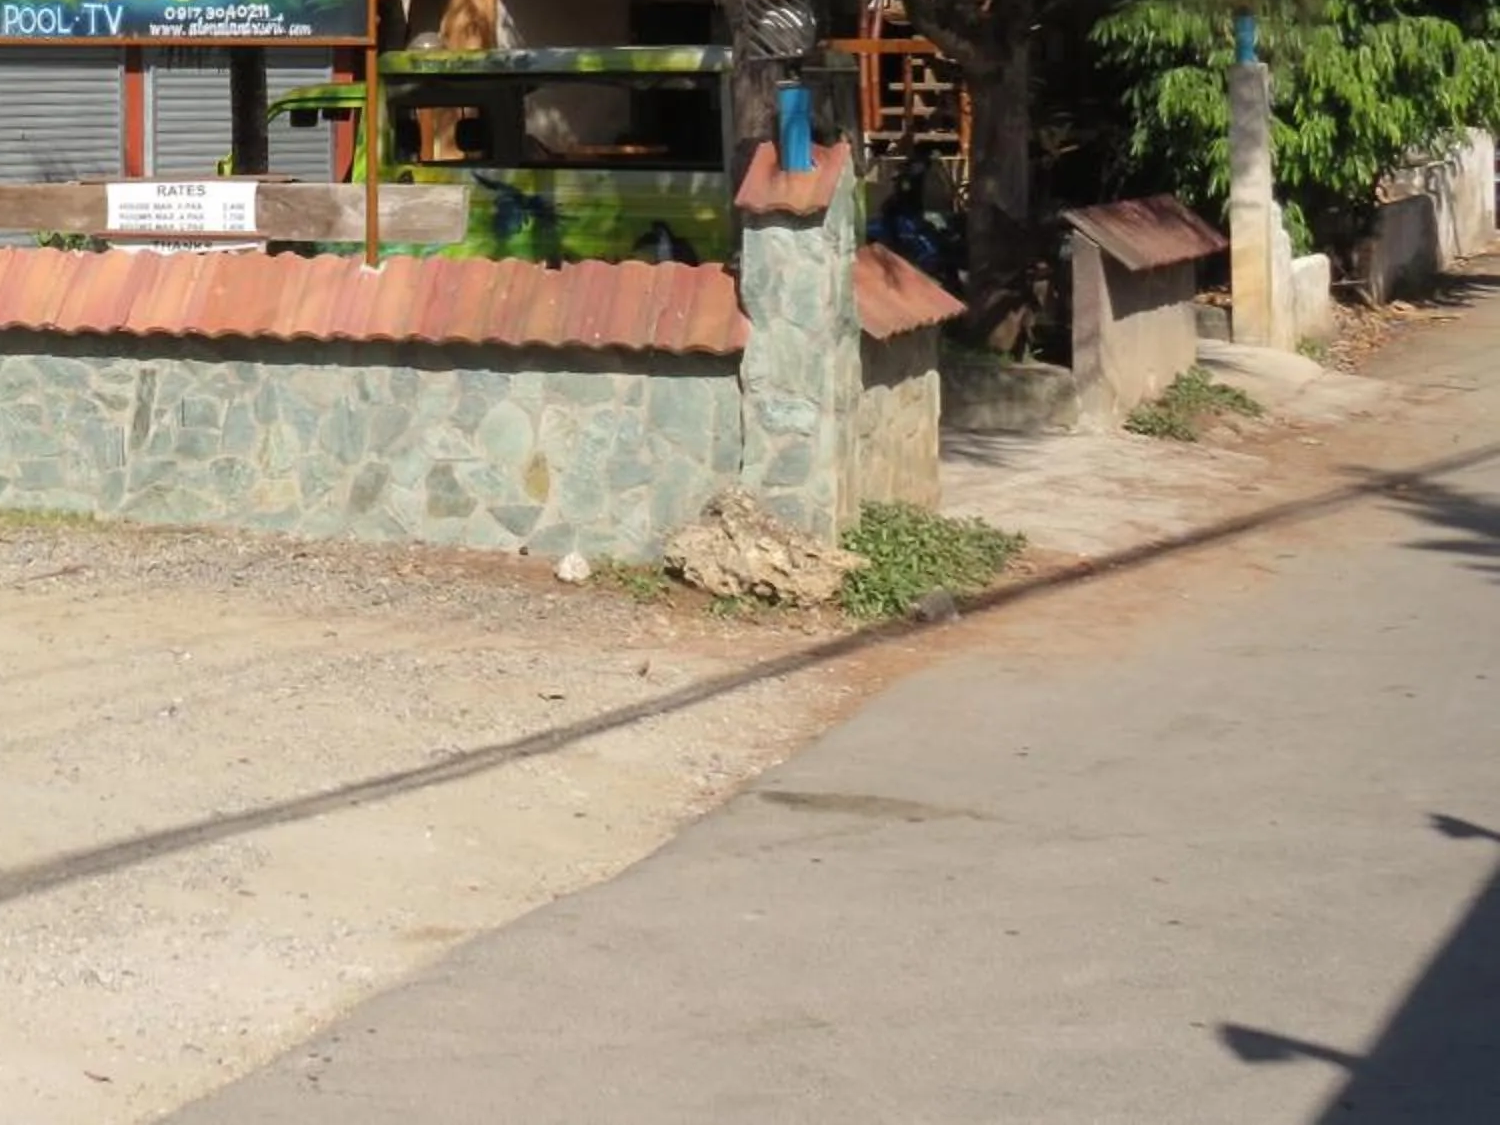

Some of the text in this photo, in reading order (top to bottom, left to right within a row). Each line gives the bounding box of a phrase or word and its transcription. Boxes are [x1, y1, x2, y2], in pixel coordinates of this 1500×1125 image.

[3, 4, 72, 35] POOL
[82, 2, 123, 35] TV
[156, 184, 207, 197] RATES
